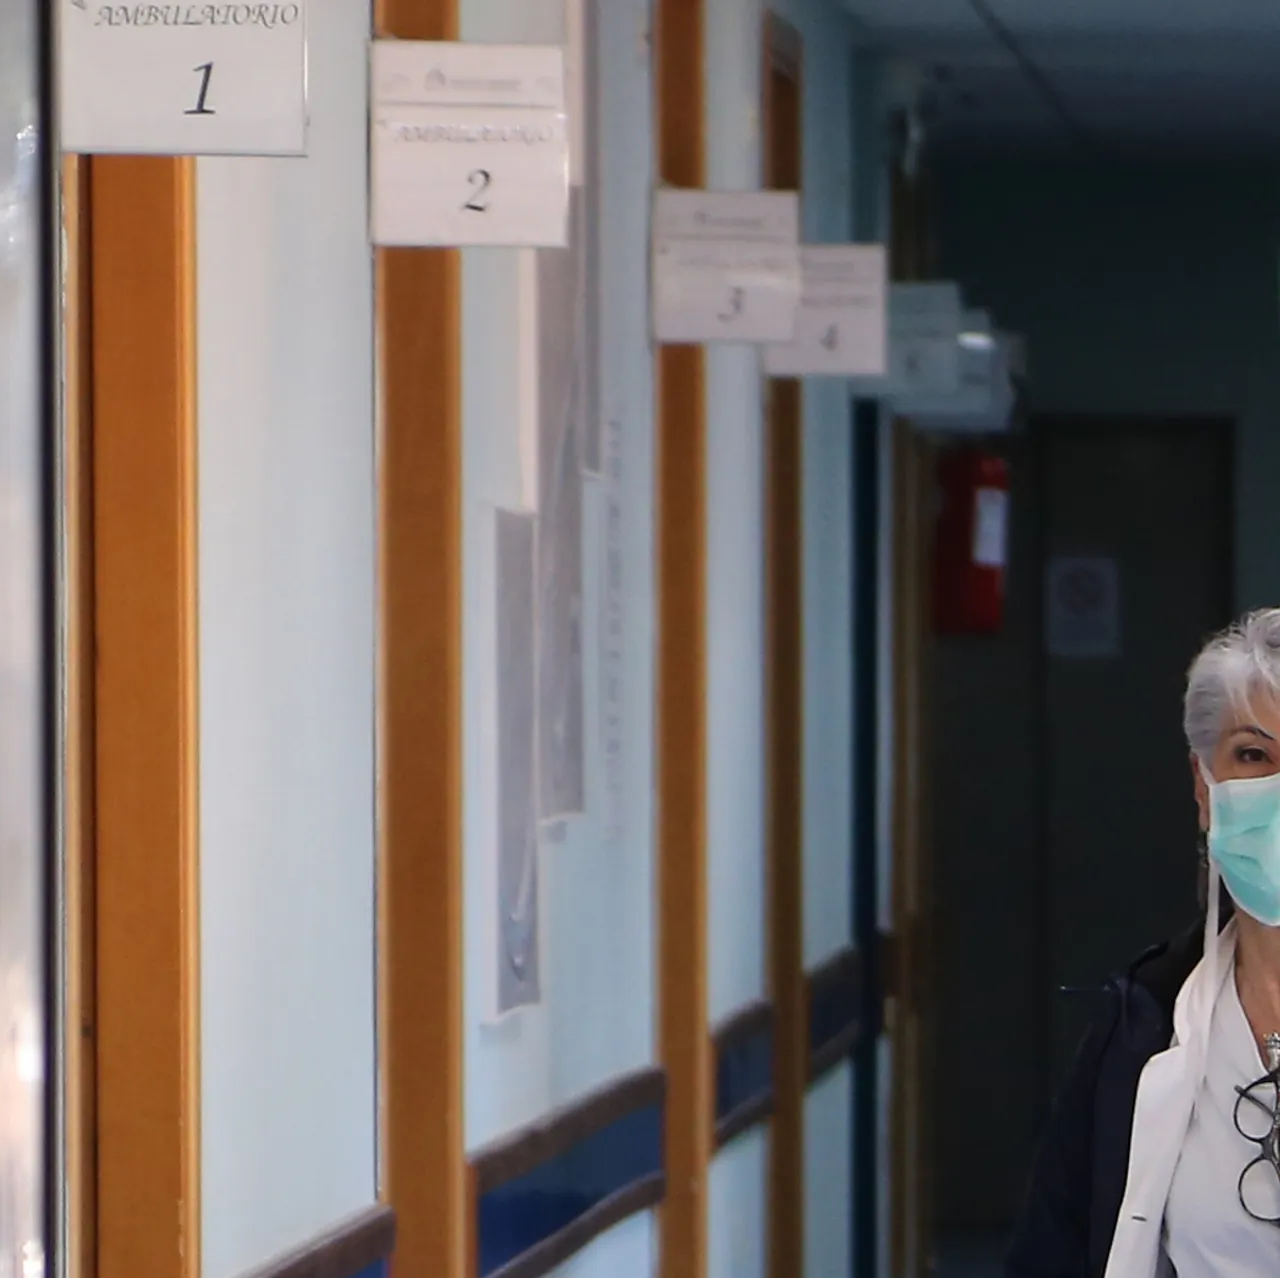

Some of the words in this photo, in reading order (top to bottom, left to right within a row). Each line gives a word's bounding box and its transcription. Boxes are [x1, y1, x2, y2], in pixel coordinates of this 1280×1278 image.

[93, 3, 299, 29] AMBULATORIO
[182, 60, 218, 115] 1
[458, 167, 494, 213] 2
